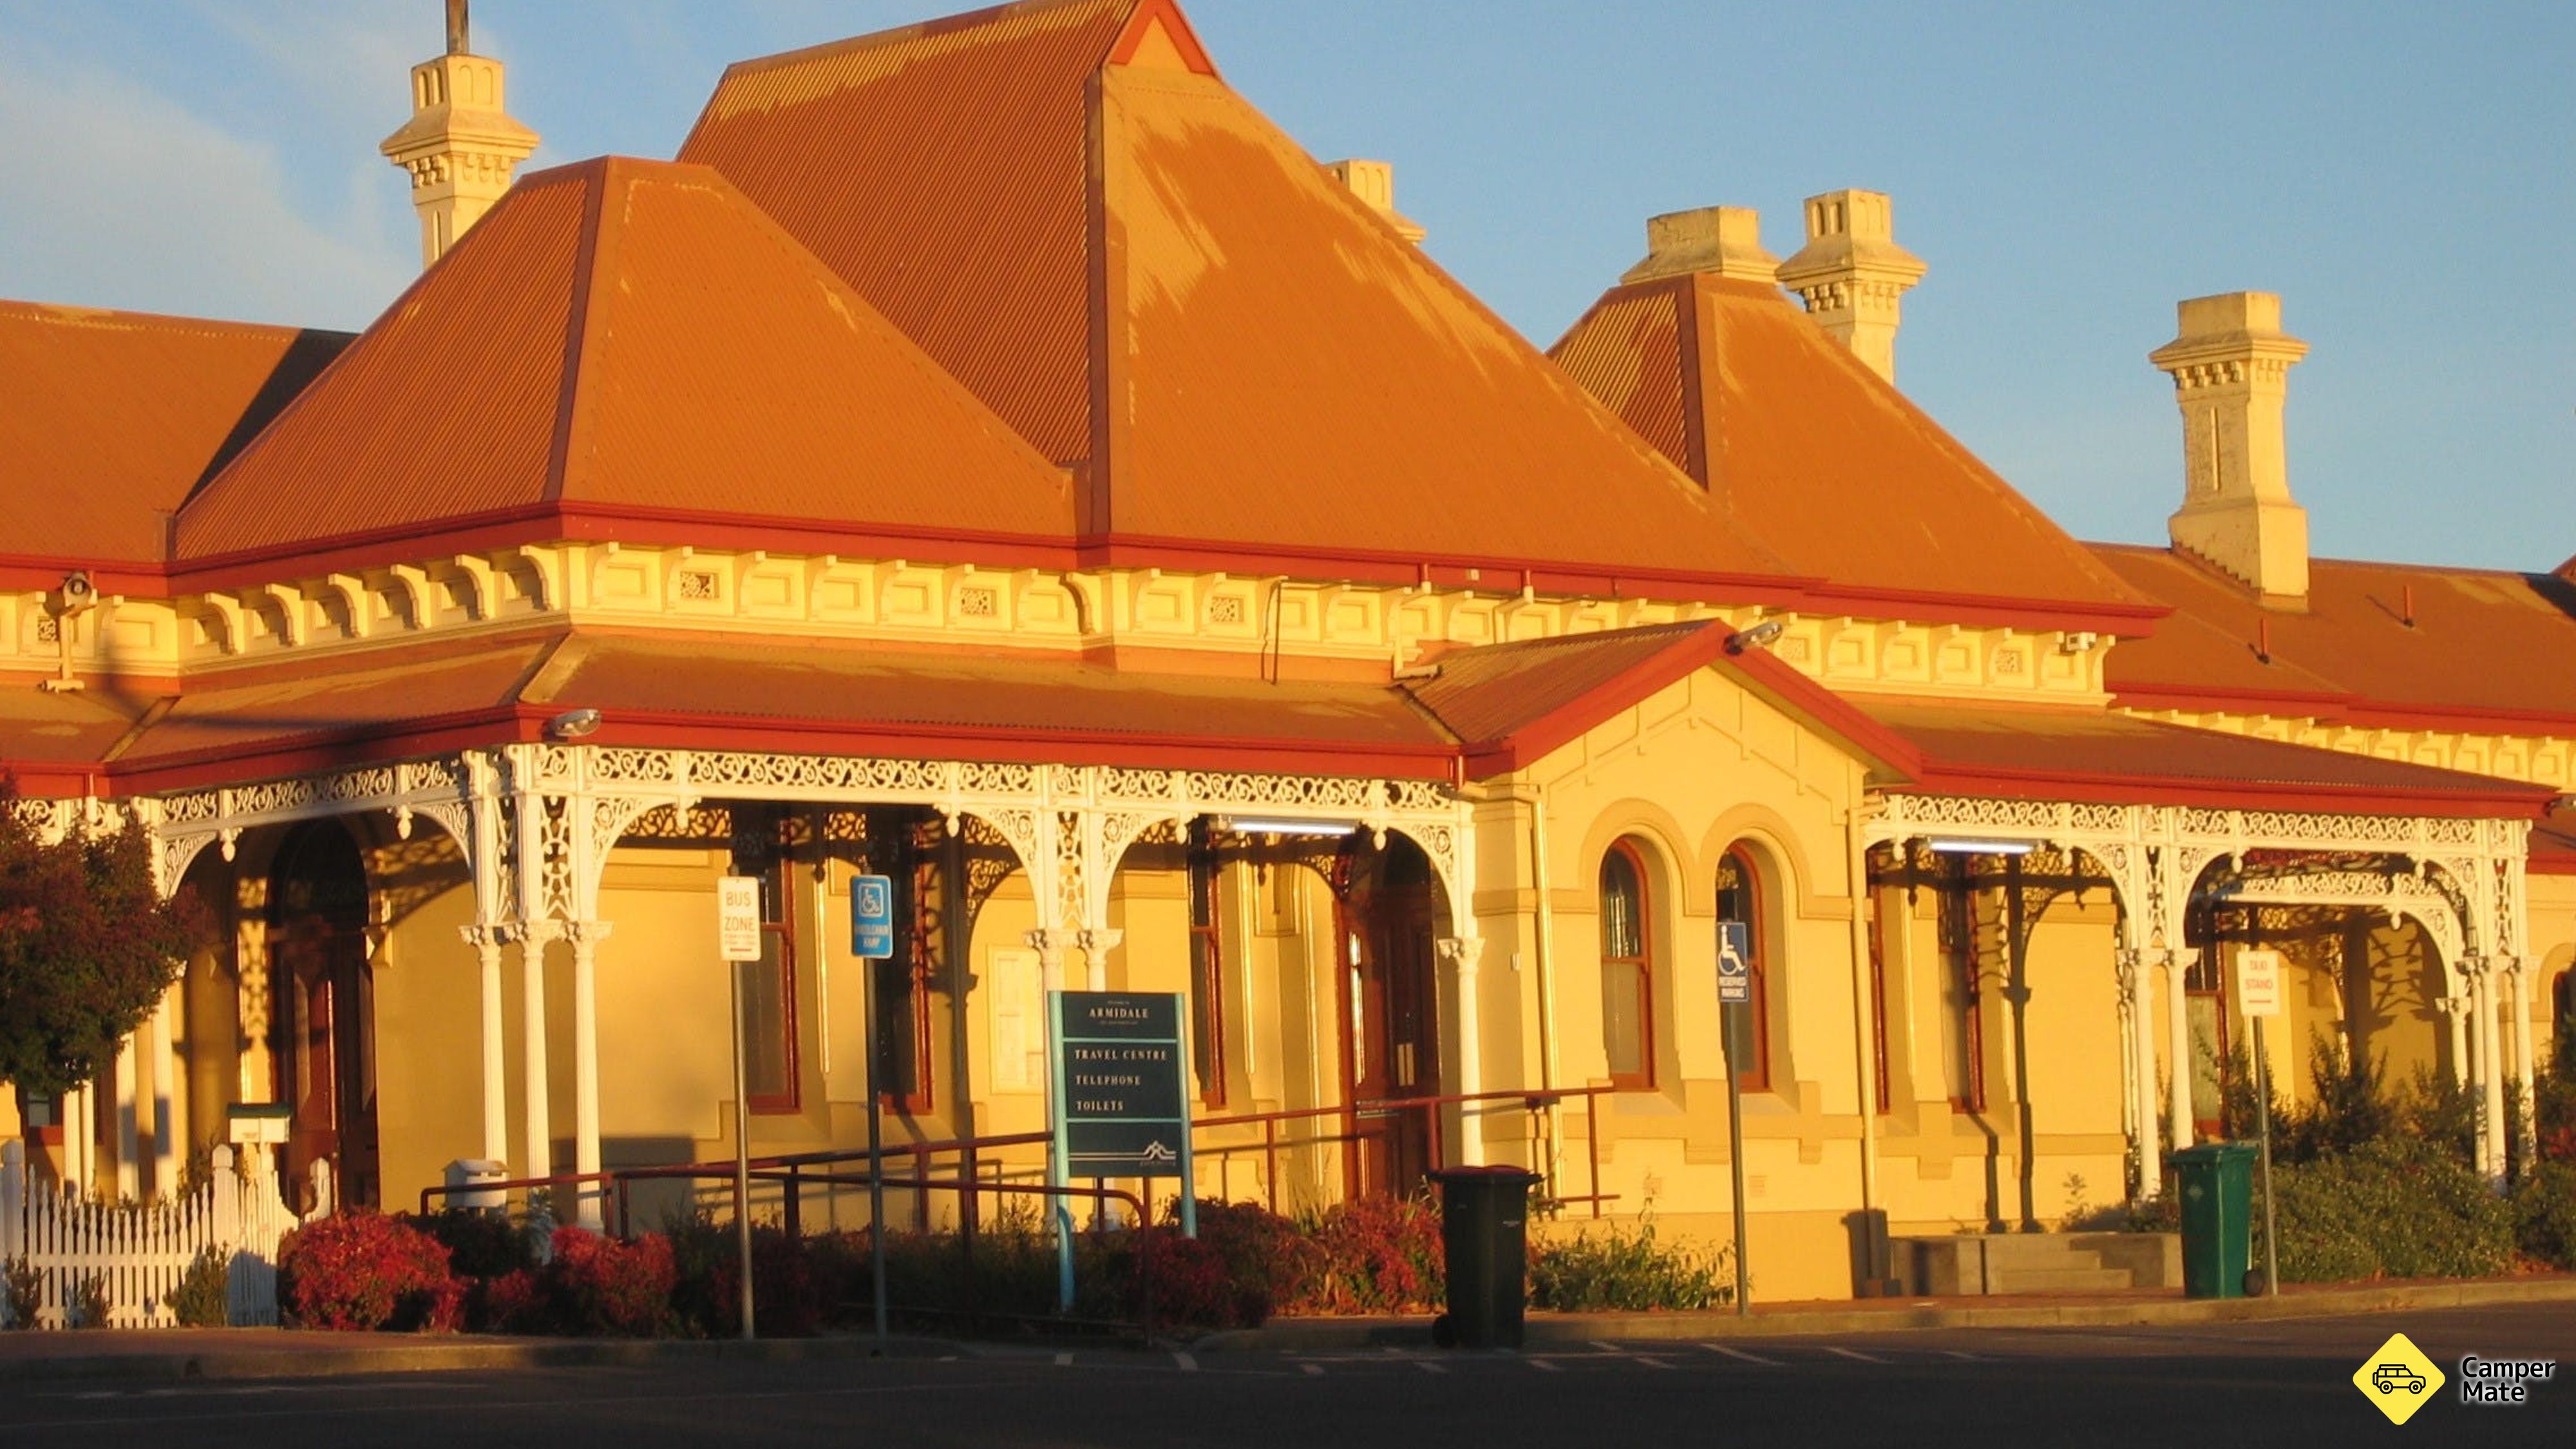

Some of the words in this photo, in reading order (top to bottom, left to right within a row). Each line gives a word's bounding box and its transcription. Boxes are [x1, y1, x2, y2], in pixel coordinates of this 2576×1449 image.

[726, 891, 752, 907] BUS
[724, 916, 755, 932] ZONE
[2245, 978, 2273, 990] STAND
[1088, 1007, 1149, 1019] ARMIDALE
[1074, 1049, 1117, 1060] TRAVEL
[1123, 1049, 1167, 1061] CENTRE
[1075, 1075, 1141, 1086] TELEPHONE
[1076, 1101, 1124, 1112] TOILETS
